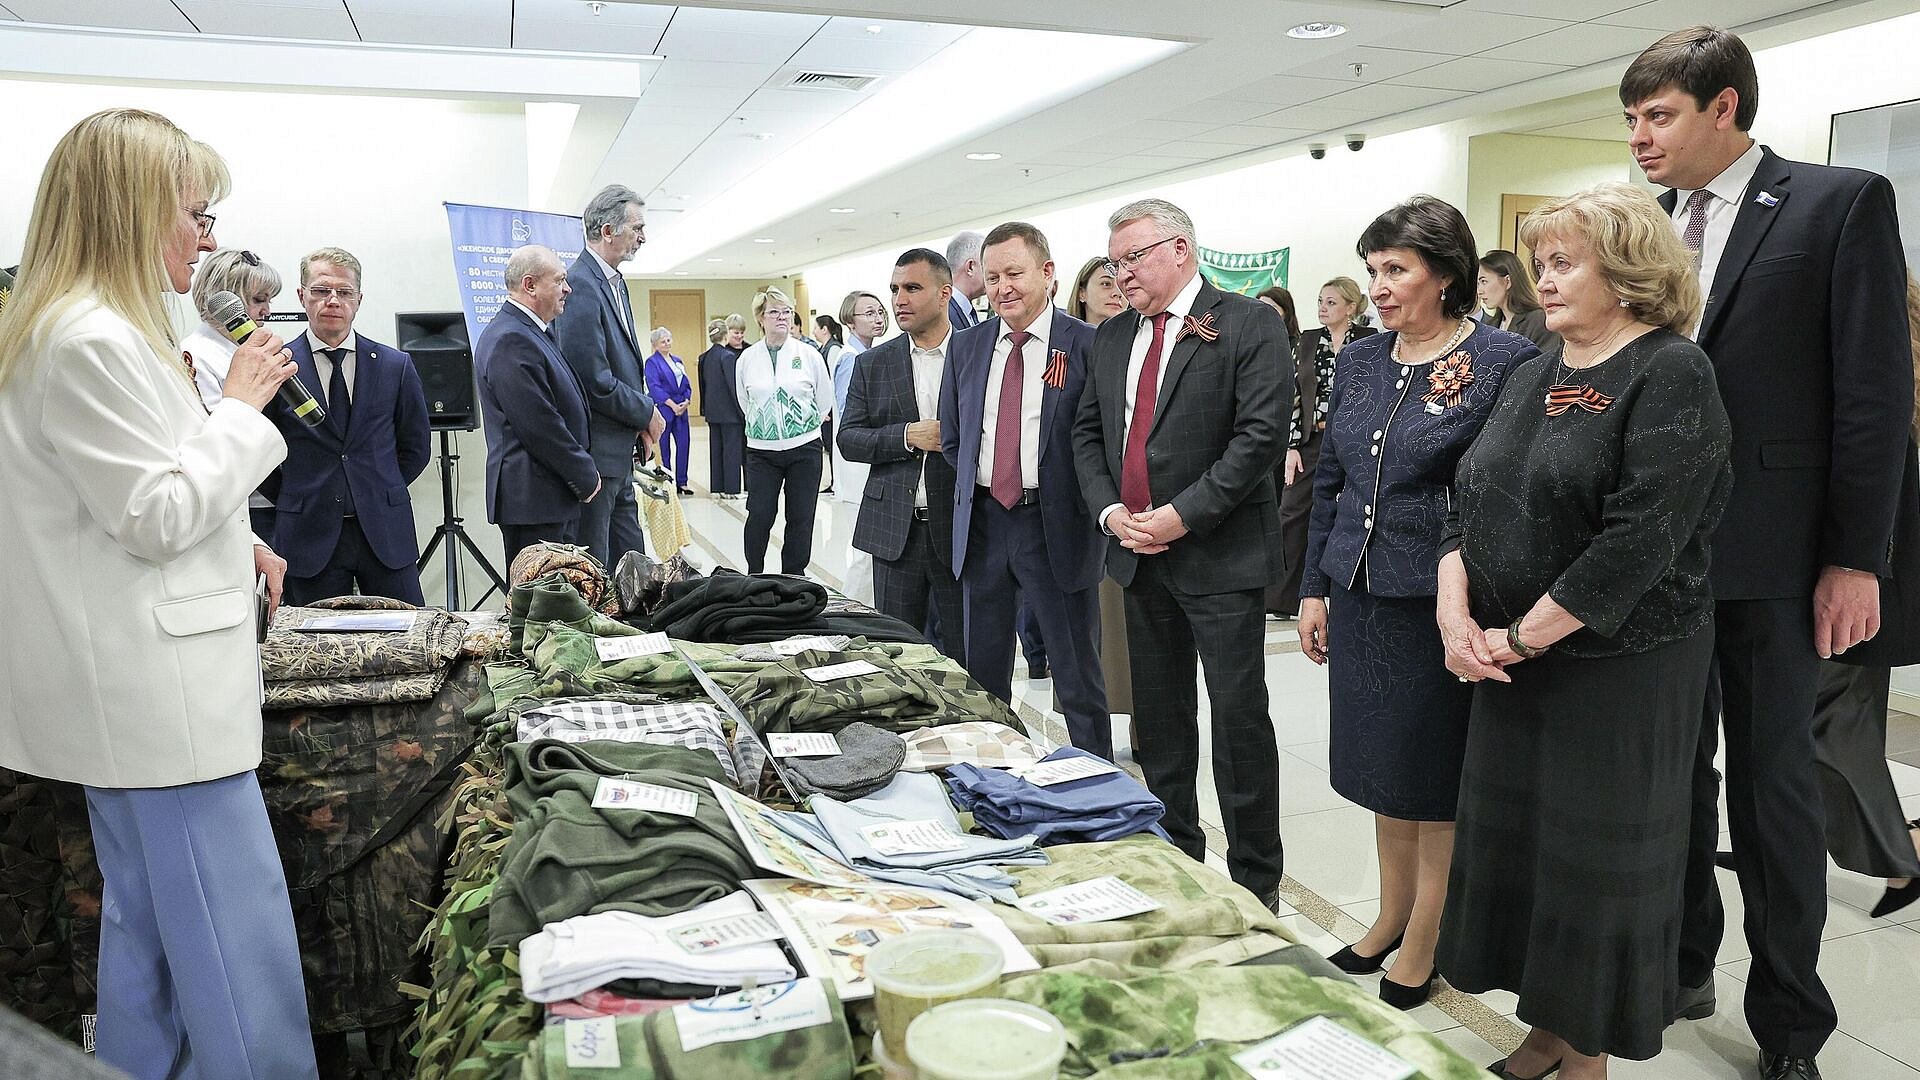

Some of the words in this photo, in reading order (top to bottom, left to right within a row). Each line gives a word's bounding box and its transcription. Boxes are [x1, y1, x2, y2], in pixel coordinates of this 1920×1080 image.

[468, 267, 480, 276] 80
[470, 280, 494, 290] 8000
[473, 295, 495, 304] БОЛЕЕ
